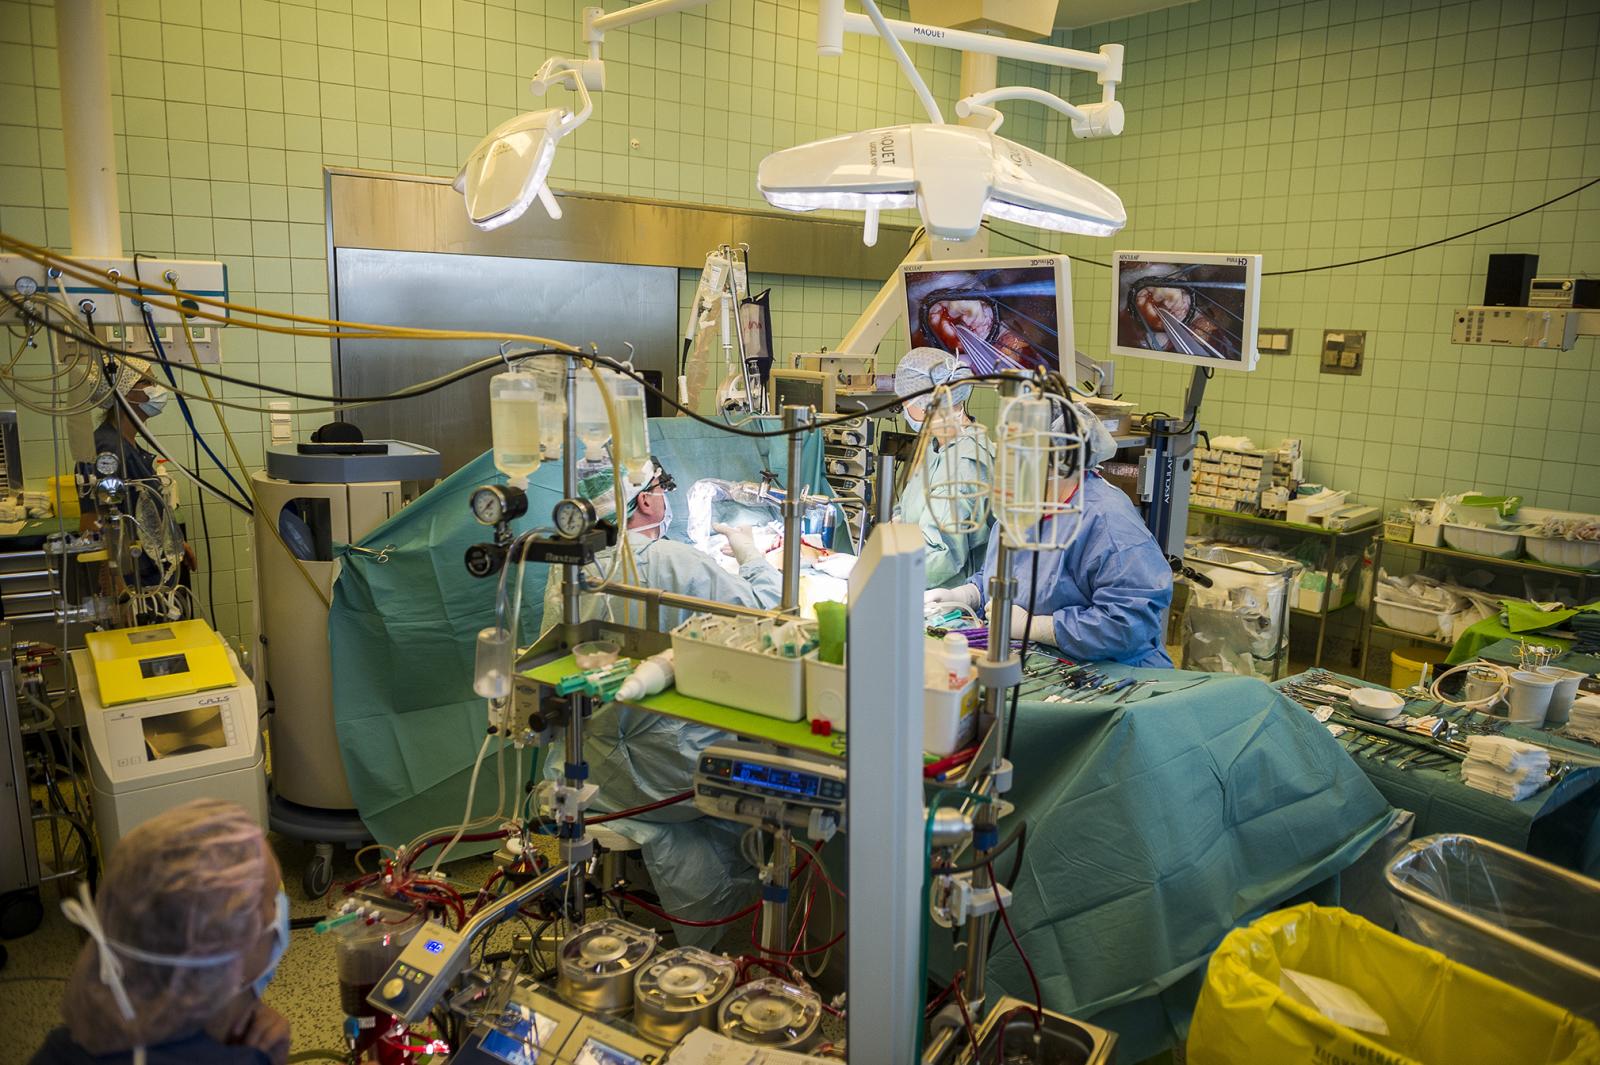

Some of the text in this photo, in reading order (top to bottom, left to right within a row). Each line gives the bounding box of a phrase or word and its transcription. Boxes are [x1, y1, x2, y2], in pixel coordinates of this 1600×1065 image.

[913, 26, 945, 38] MAQUET
[1163, 457, 1173, 504] AESCULAP
[545, 552, 581, 563] Baxter
